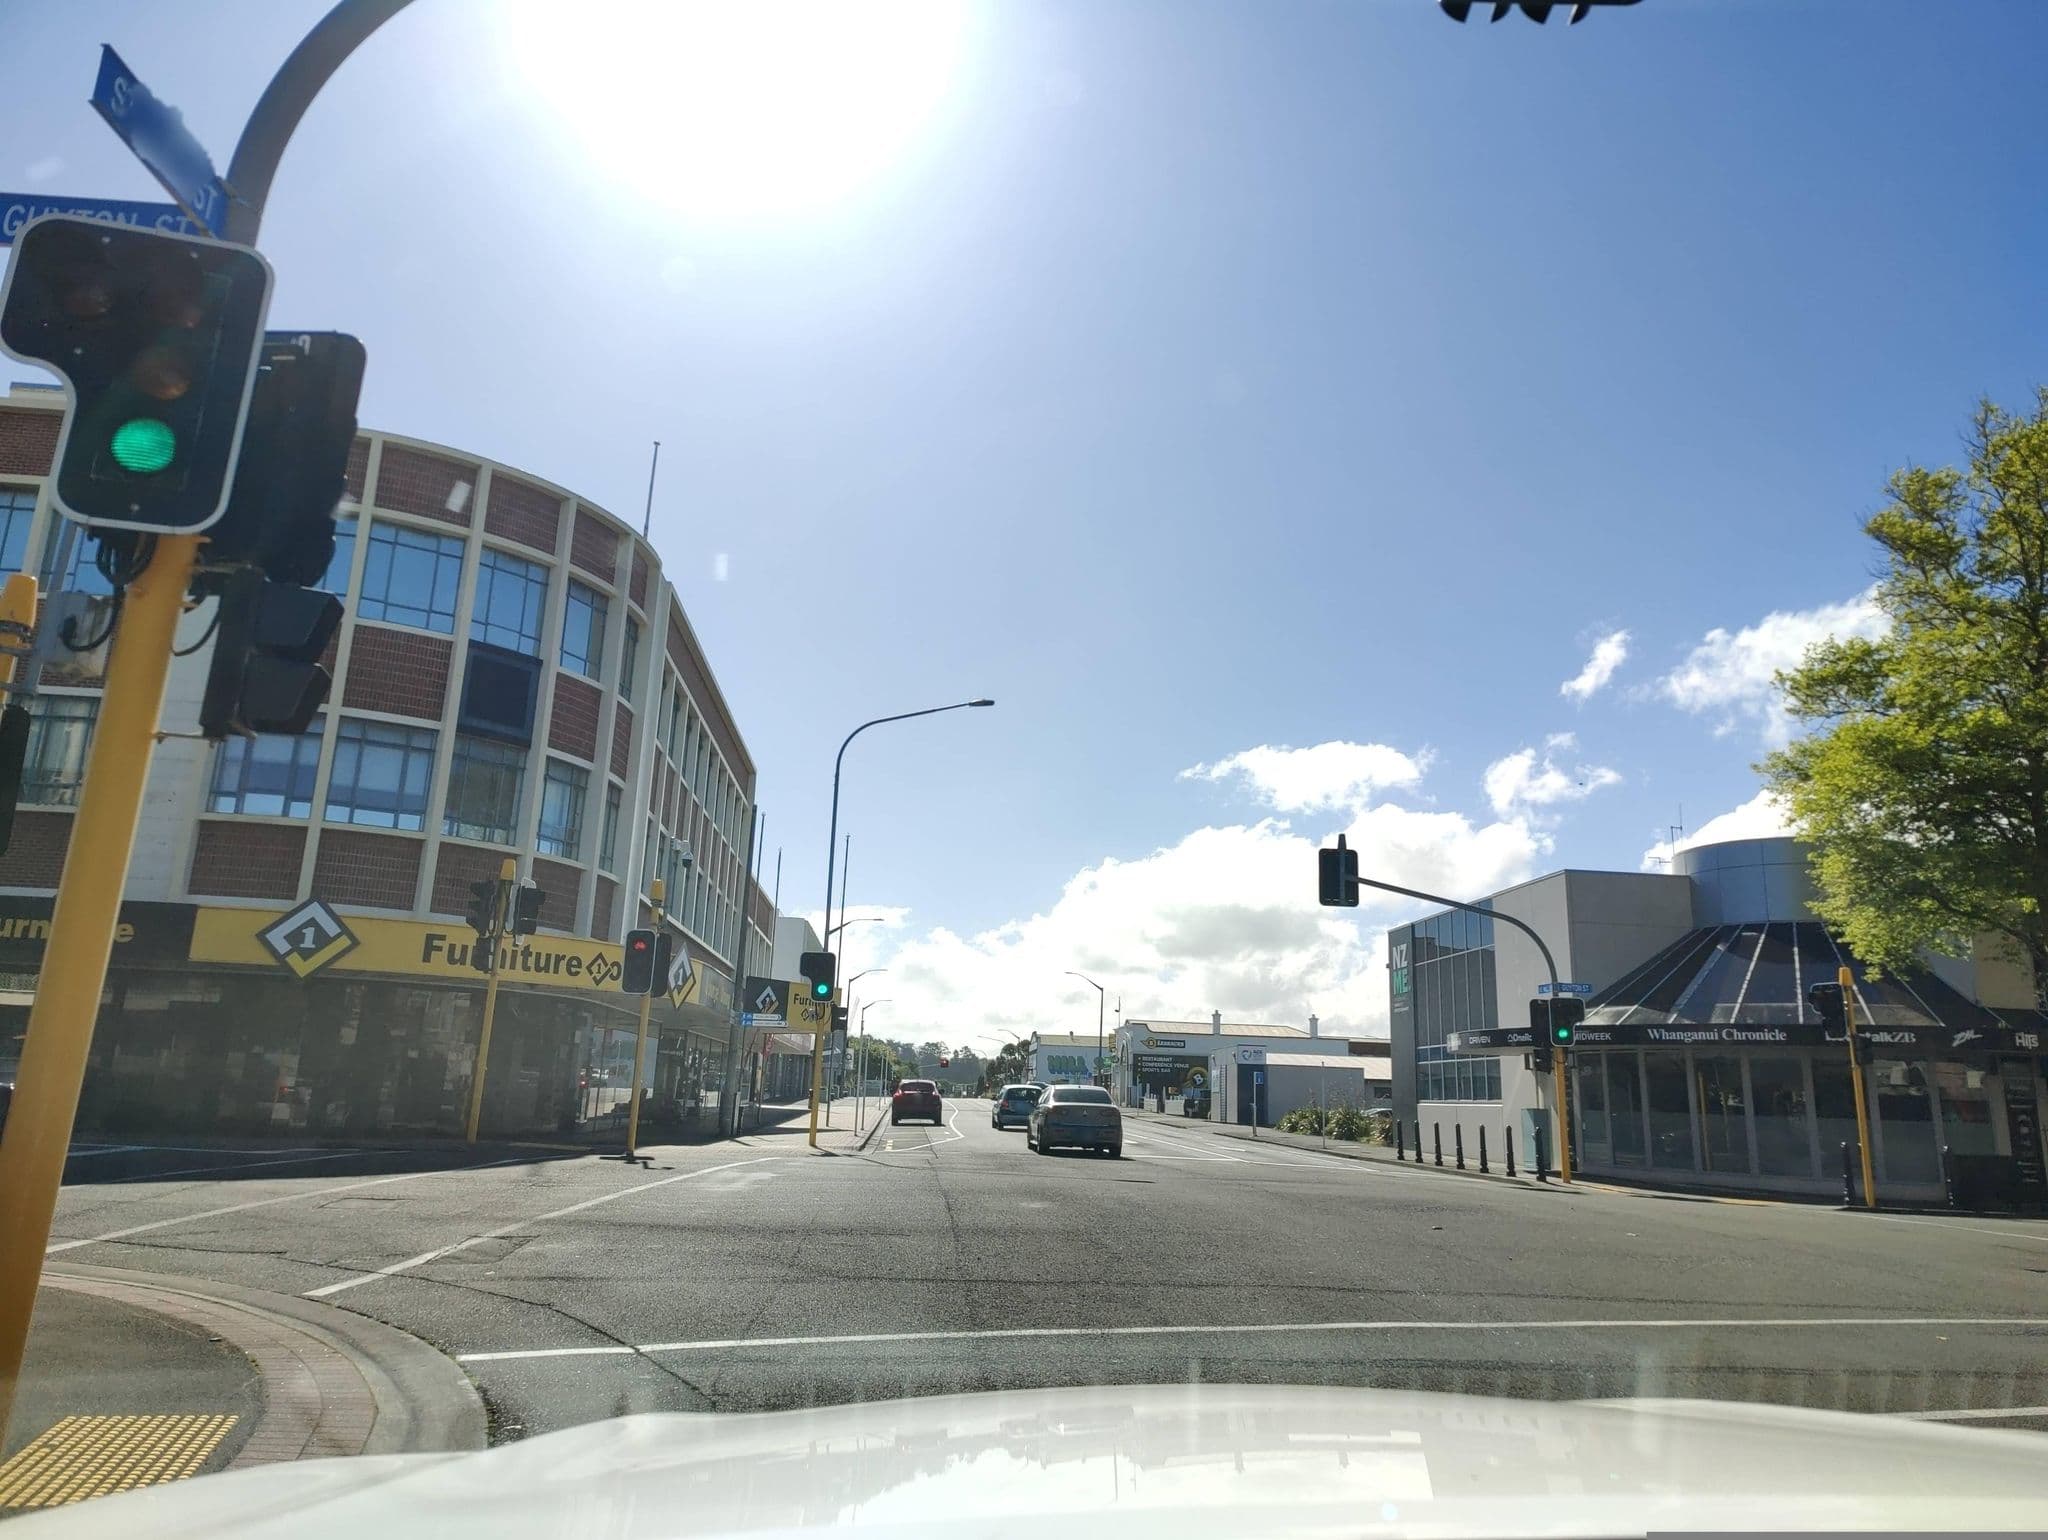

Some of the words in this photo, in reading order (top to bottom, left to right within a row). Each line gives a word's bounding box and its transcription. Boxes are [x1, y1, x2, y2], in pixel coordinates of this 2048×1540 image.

[299, 926, 316, 949] 1
[421, 932, 582, 977] Fuiture
[1392, 943, 1408, 970] NZ
[1647, 1028, 1719, 1043] Whanganui
[1721, 1028, 1788, 1041] Chronicle
